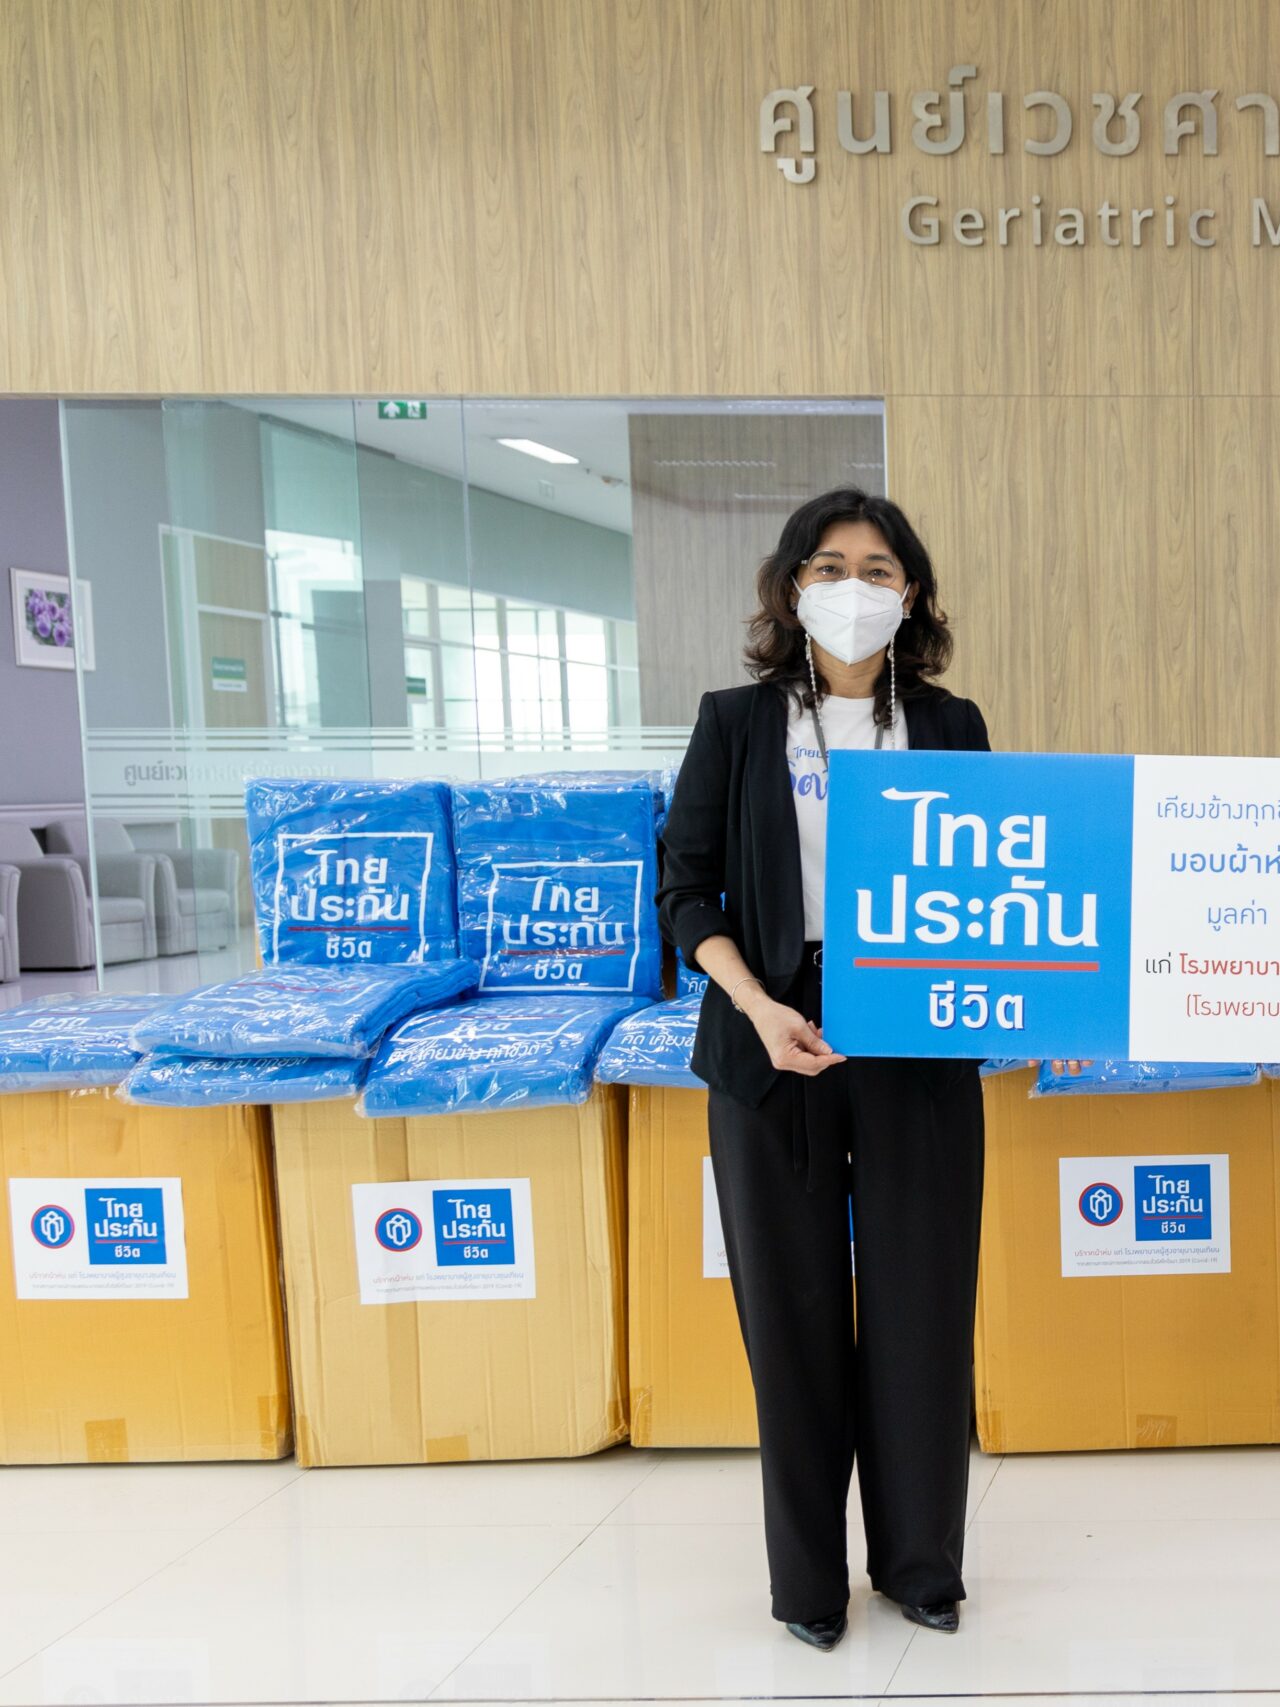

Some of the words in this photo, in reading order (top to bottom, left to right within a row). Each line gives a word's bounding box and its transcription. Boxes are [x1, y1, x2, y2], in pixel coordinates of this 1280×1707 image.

[904, 196, 1217, 250] Geriatric
[881, 787, 1047, 870] ไทย
[304, 848, 388, 886] ไทย
[290, 886, 410, 921] ประกัน
[856, 875, 1099, 948] ประกัน
[1207, 899, 1267, 931] มูลค่า
[502, 914, 625, 947] ประกัน
[326, 935, 372, 959] ชีวิต
[534, 958, 583, 980] ชีวิต
[1145, 952, 1171, 974] แก่
[929, 983, 1026, 1031] ชีวิต
[1147, 1174, 1190, 1195] ไทย
[98, 1197, 143, 1218] ไทย
[447, 1199, 492, 1219] ไทย
[1142, 1195, 1203, 1213] ประกัน
[94, 1218, 158, 1238] ประกัน
[442, 1220, 506, 1239] ประกัน
[1161, 1221, 1186, 1234] ชีวิต
[114, 1245, 141, 1258] ชีวิต
[463, 1246, 489, 1259] ชีวิต
